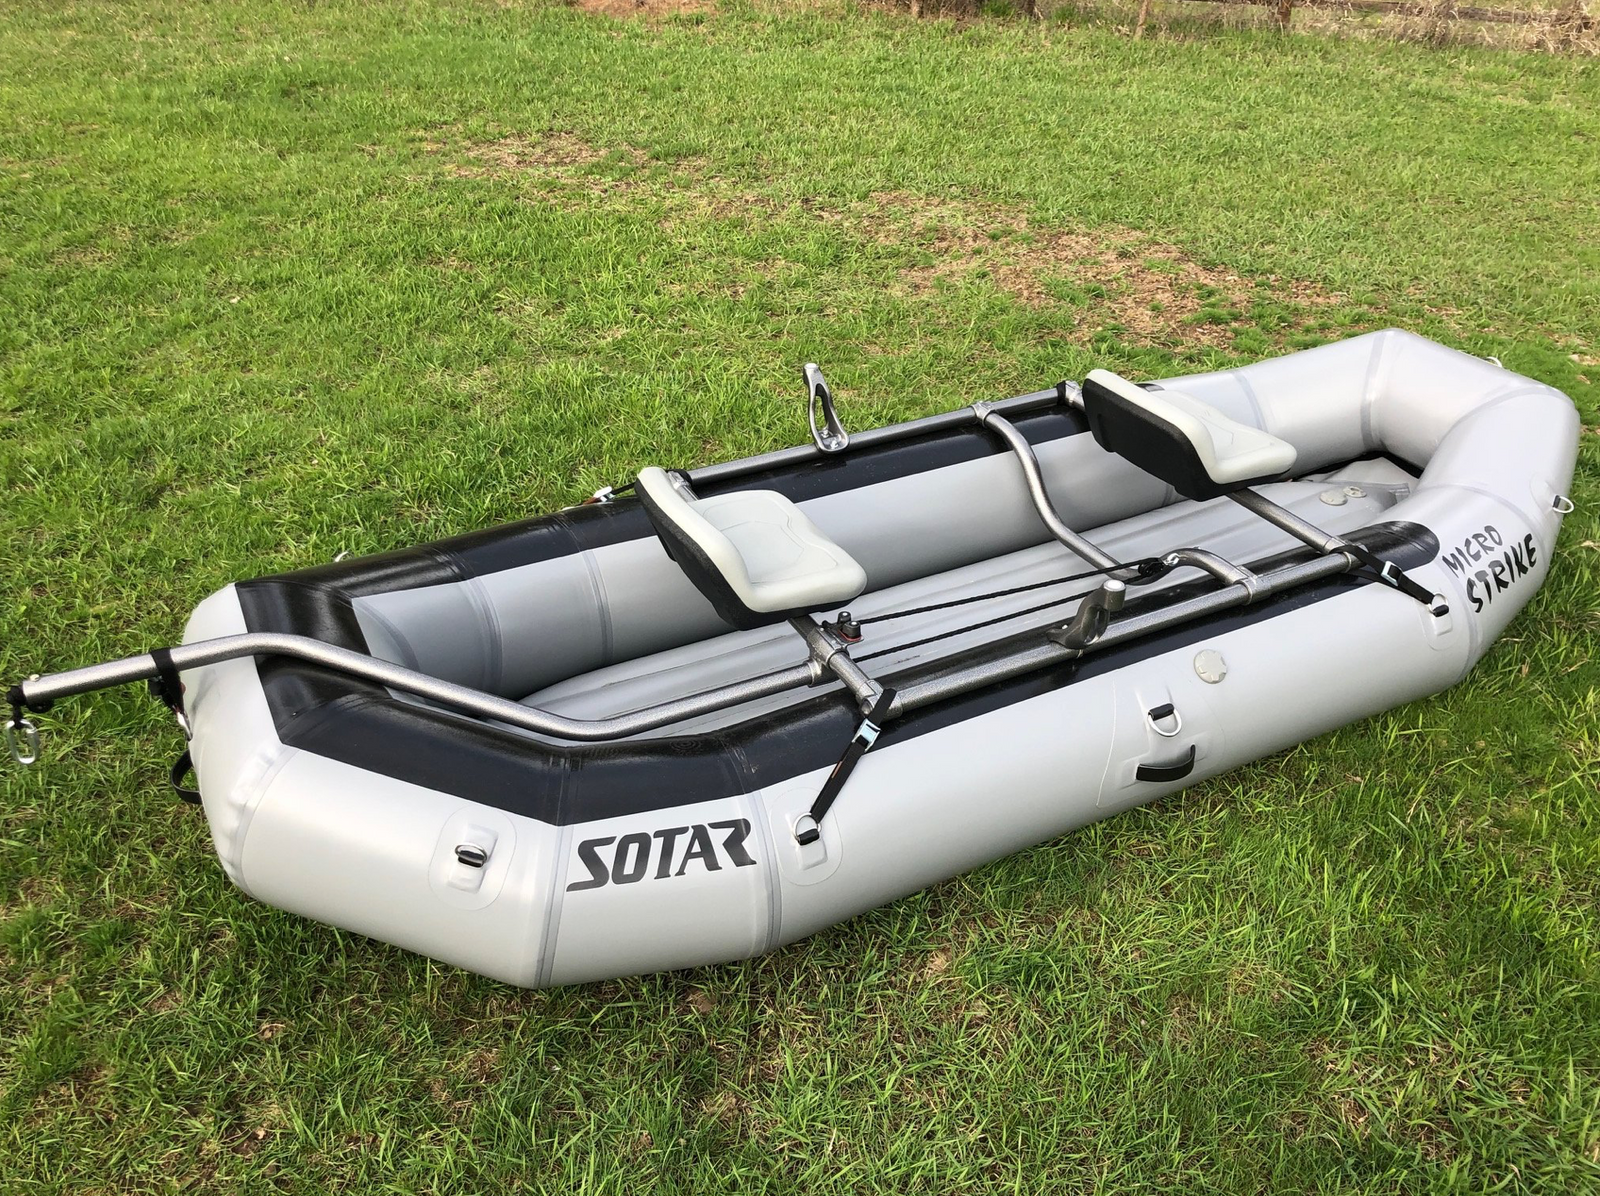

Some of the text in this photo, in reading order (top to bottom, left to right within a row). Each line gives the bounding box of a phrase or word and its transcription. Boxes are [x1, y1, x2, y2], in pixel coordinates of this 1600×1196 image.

[1441, 525, 1503, 578] MICRO
[1466, 533, 1537, 613] STRIKE
[566, 818, 757, 892] SOTAR
